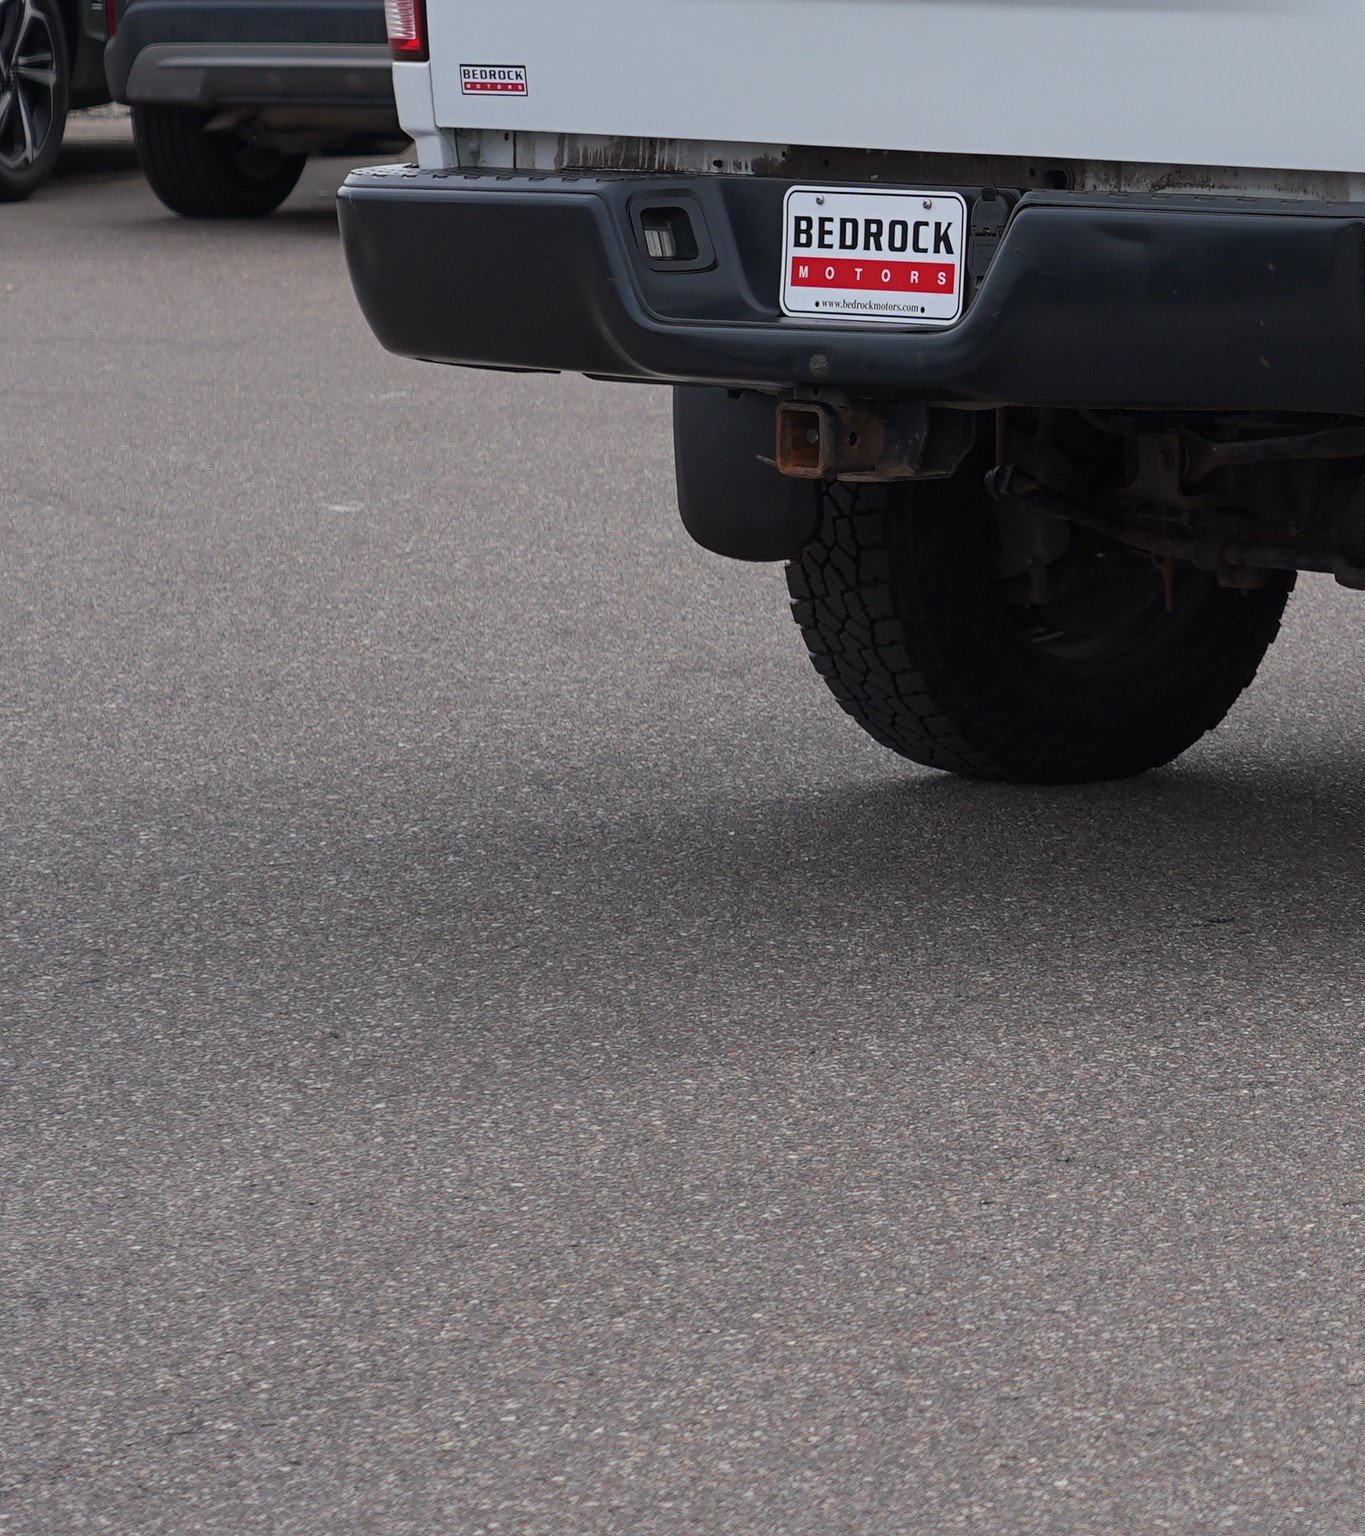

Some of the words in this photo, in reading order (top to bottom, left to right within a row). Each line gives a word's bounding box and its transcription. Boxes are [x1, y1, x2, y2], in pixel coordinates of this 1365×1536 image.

[463, 69, 524, 81] BEDROCK
[793, 216, 954, 254] BEDROCK
[799, 265, 947, 285] MOTORS
[822, 298, 919, 313] www.bedrockmotors.com
